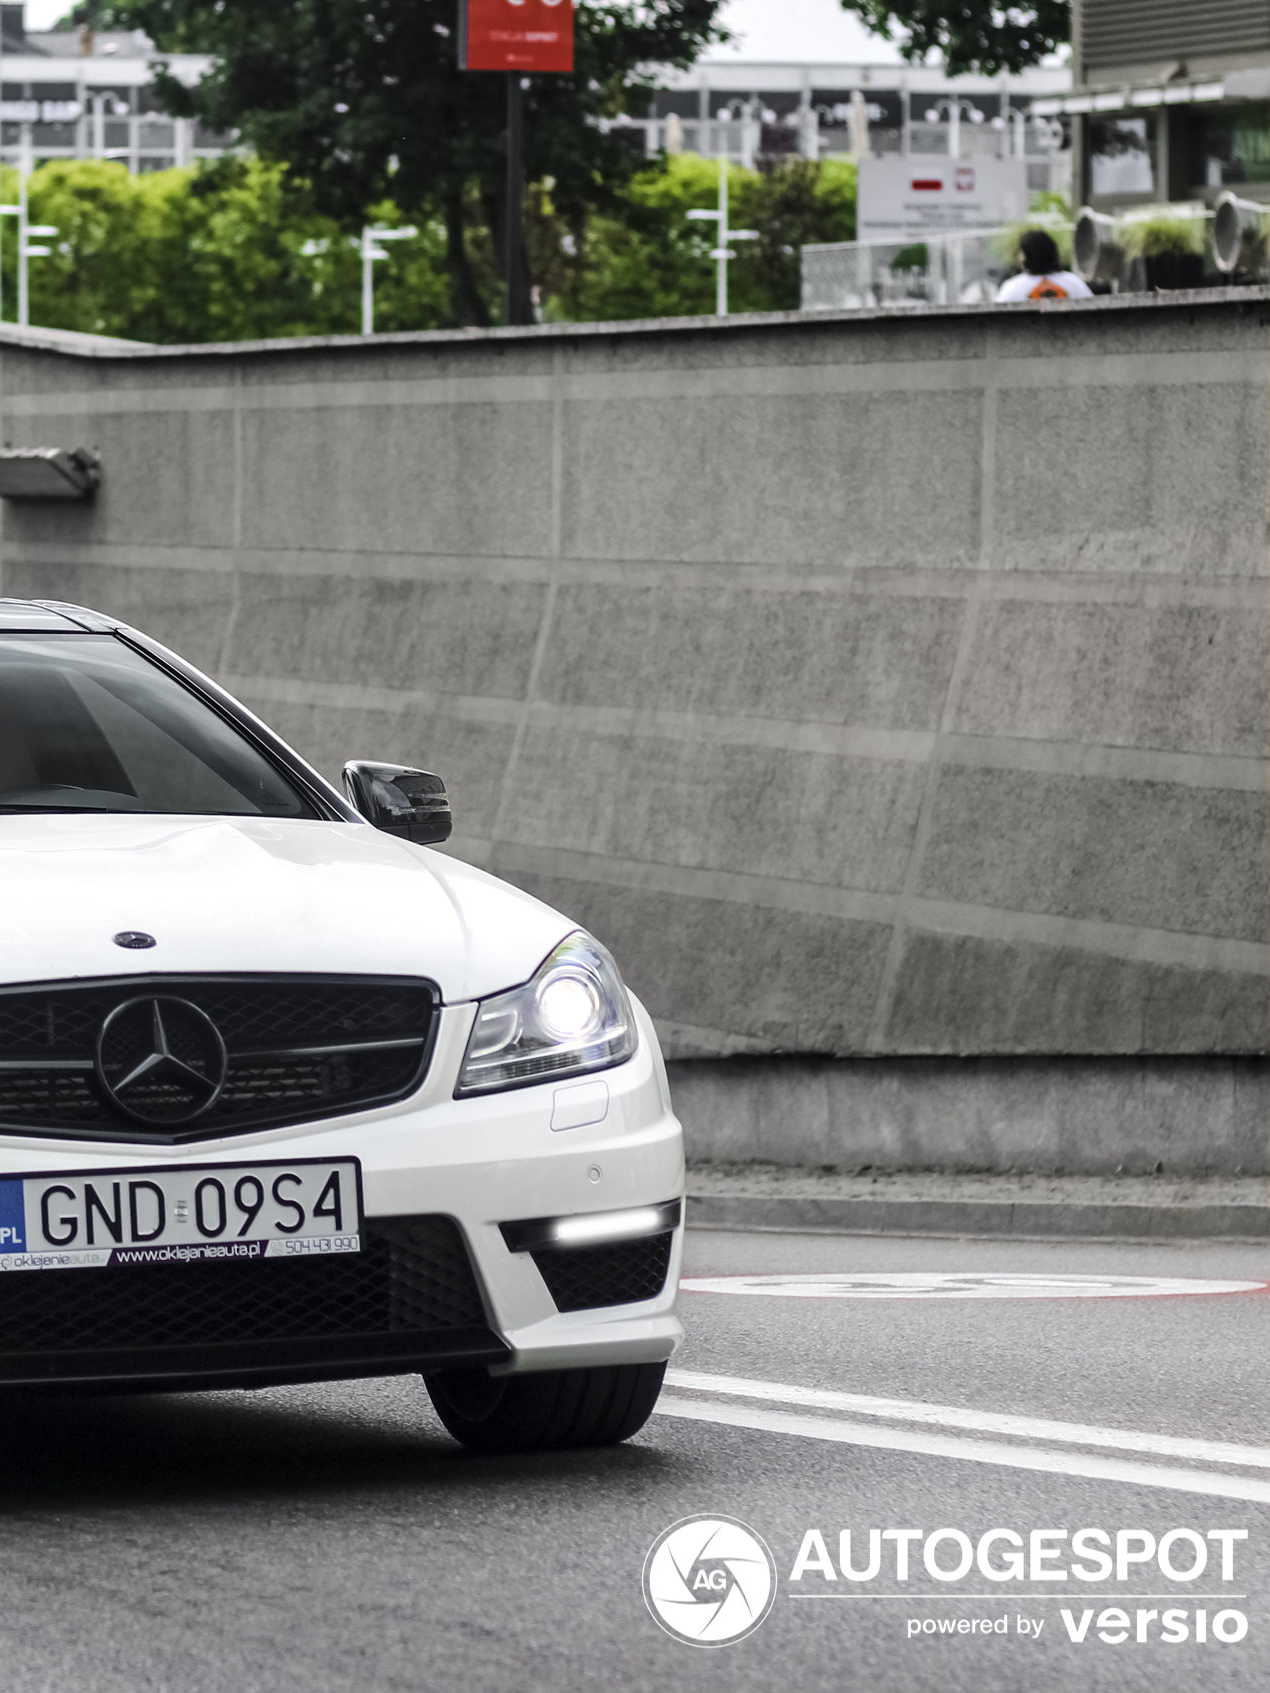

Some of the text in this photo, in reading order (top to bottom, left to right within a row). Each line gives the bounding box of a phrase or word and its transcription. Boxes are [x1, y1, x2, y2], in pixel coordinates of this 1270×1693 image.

[41, 1170, 343, 1246] GND 09S4
[0, 1227, 22, 1244] PL
[285, 1240, 311, 1254] 504
[334, 1236, 359, 1251] 990
